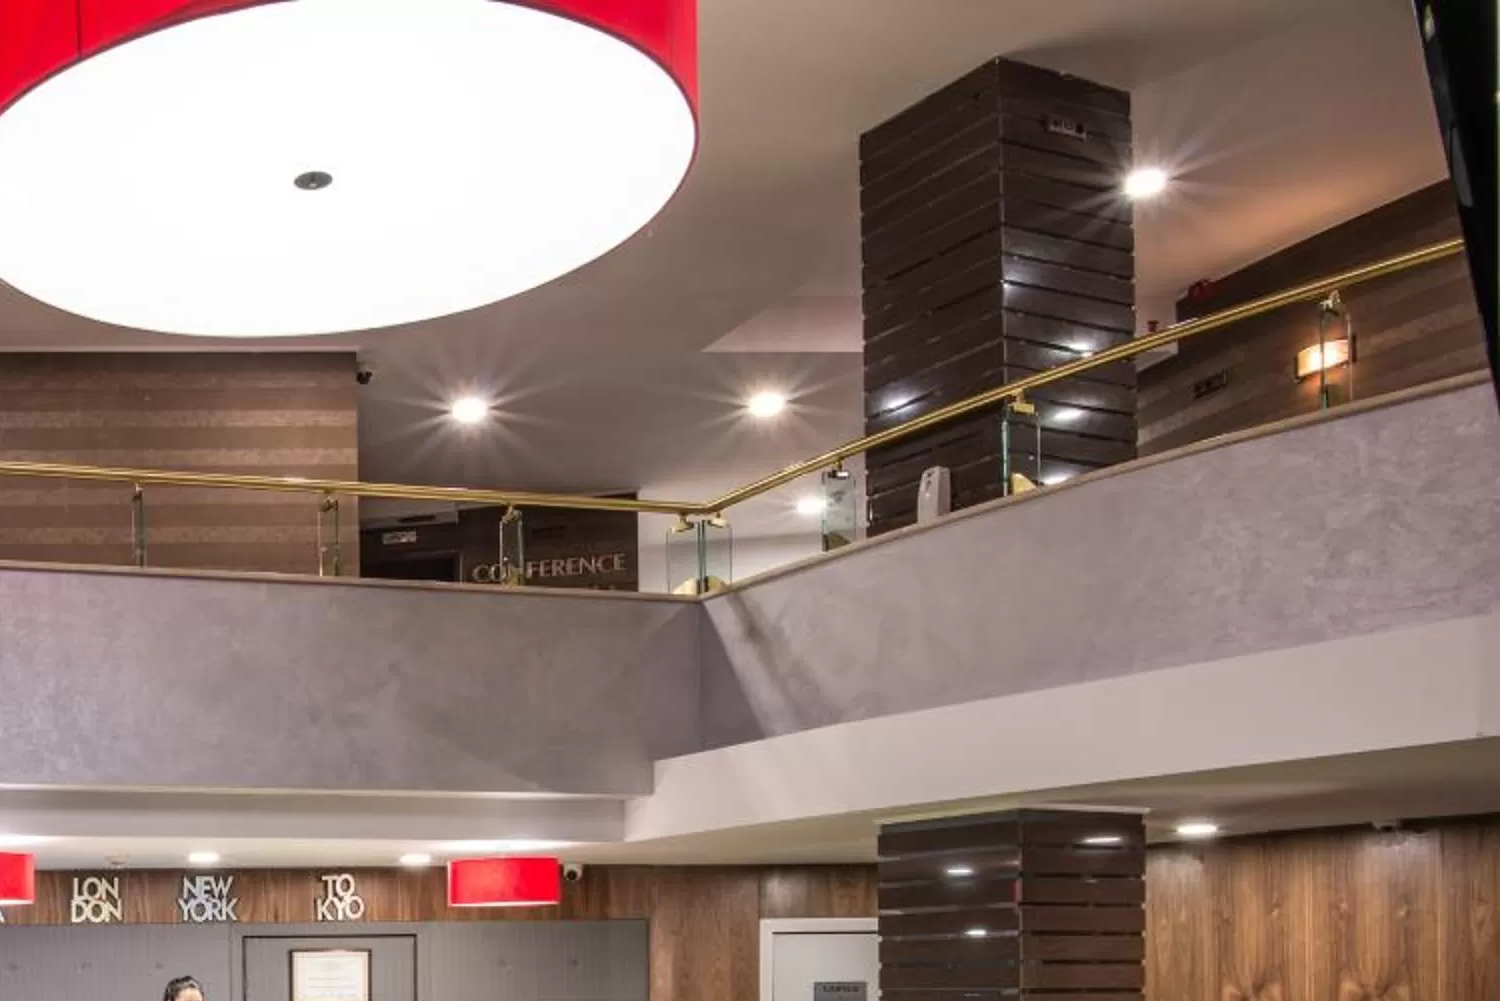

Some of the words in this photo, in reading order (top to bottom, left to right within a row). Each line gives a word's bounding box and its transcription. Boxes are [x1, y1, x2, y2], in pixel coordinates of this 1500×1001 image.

[73, 876, 119, 900] LON
[183, 875, 235, 899] NEW
[321, 873, 355, 897] TO
[71, 897, 122, 923] DON
[177, 897, 239, 923] YORK
[317, 895, 365, 921] KYO
